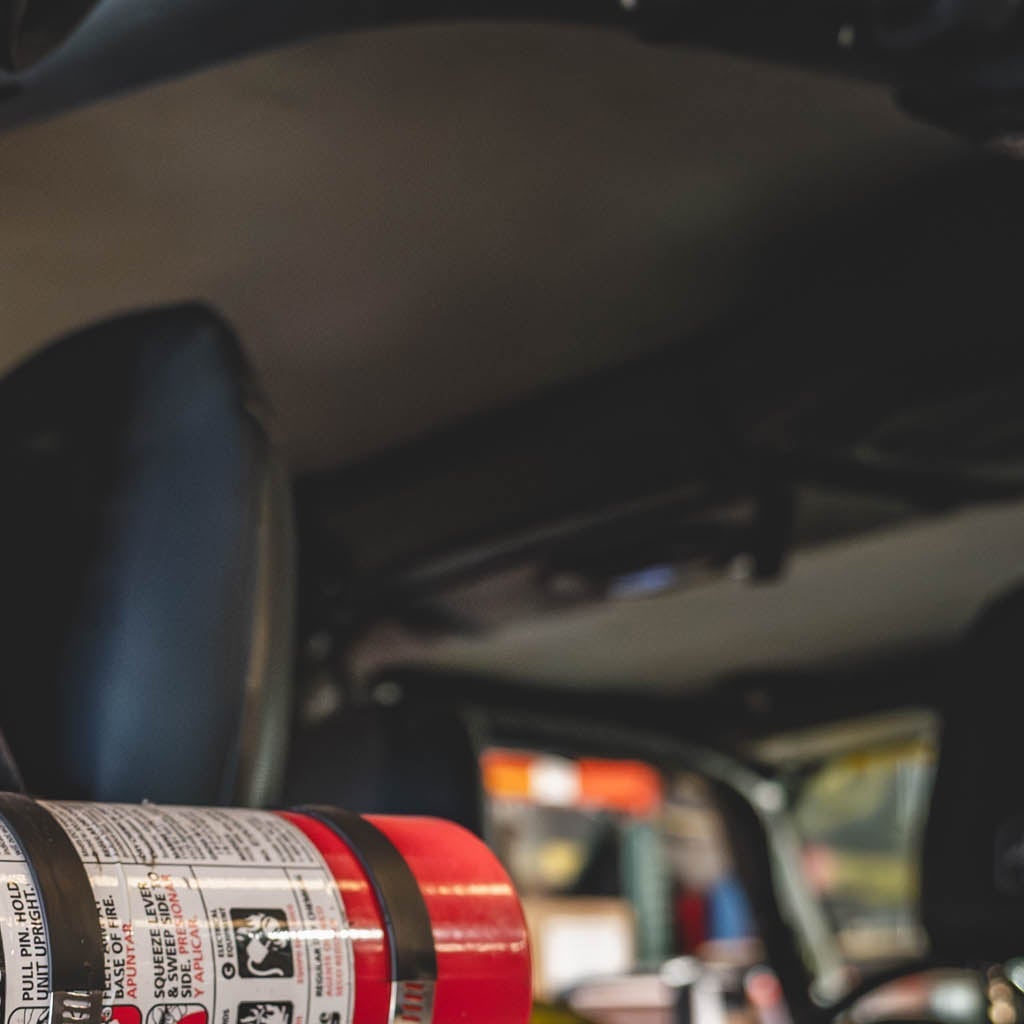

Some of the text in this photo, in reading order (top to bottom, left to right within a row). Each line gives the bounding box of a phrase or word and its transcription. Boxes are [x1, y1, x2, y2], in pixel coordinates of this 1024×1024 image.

[7, 881, 34, 1001] PULL PIN. HOLD
[138, 882, 166, 999] SQUEEZE LEVER
[157, 893, 172, 925] SIDE
[23, 887, 49, 1001] UNIT UPRIGHT.
[102, 895, 125, 999] BASE OF FIRE.
[122, 922, 137, 999] APUNTAR
[163, 930, 179, 986] SWEEP
[168, 986, 179, 998] &
[180, 959, 193, 998] SIDE.
[194, 988, 205, 998] Y
